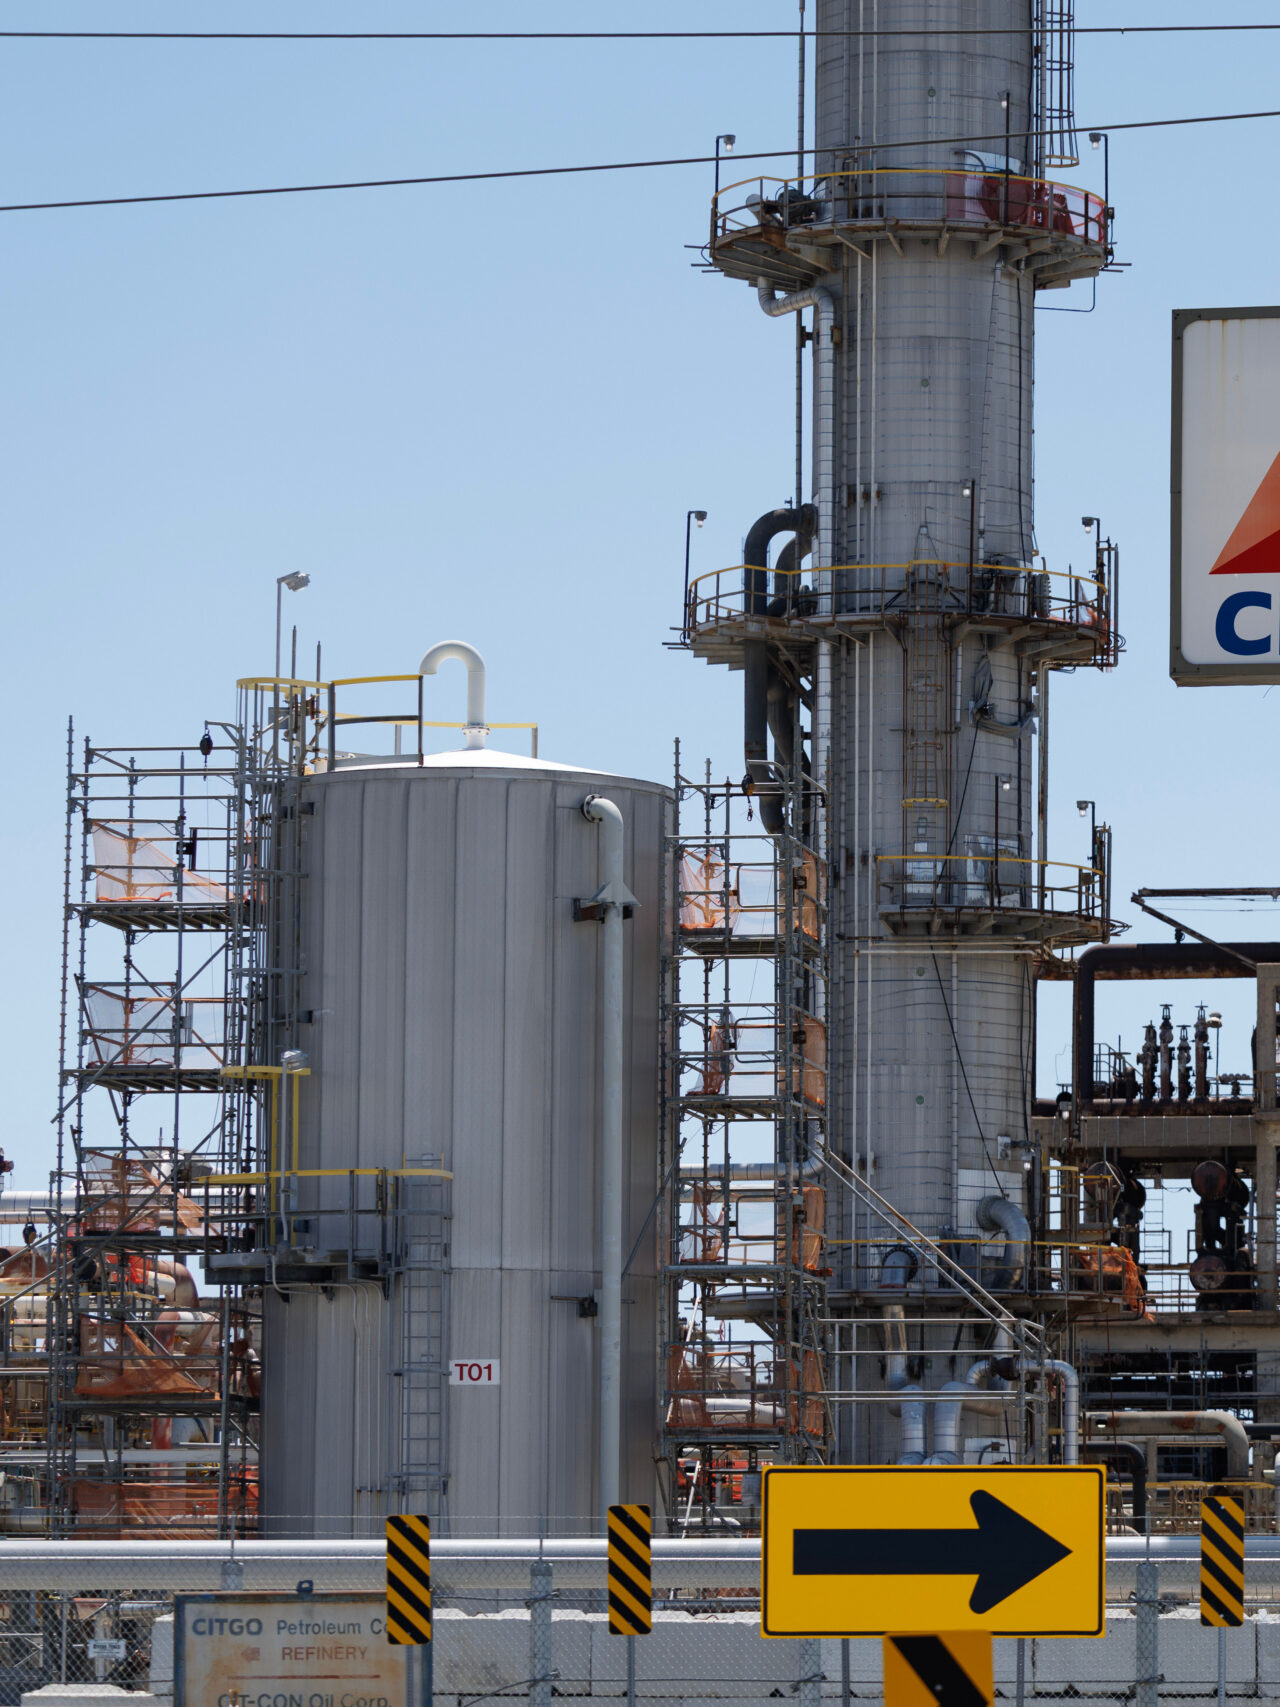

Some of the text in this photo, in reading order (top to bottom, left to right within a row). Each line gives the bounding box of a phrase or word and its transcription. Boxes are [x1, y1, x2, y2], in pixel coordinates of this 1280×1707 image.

[191, 1617, 264, 1636] CITGO
[276, 1618, 361, 1636] Petroleum
[281, 1646, 368, 1661] REFINERY
[309, 1692, 334, 1707] Oil
